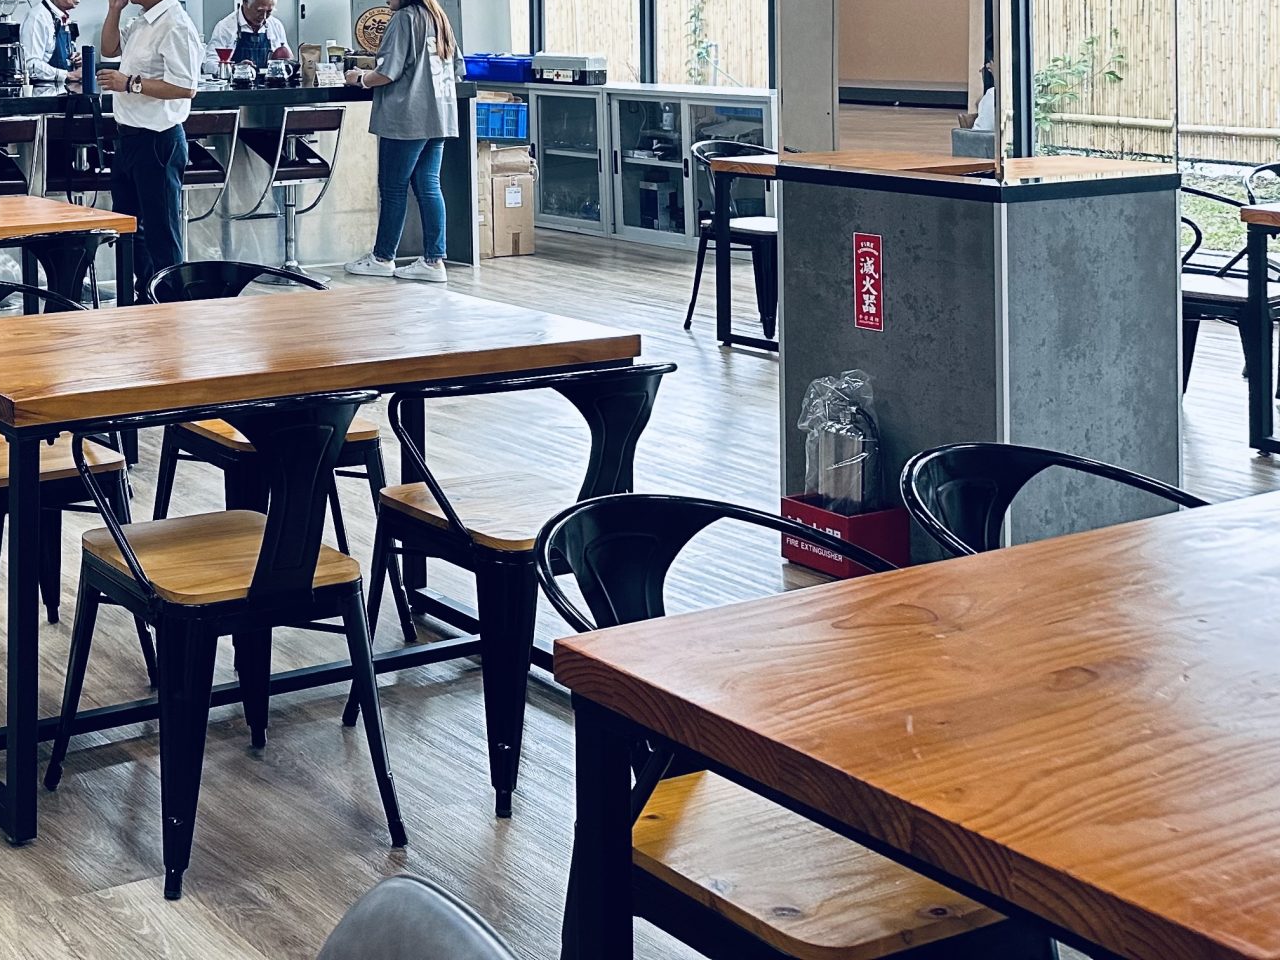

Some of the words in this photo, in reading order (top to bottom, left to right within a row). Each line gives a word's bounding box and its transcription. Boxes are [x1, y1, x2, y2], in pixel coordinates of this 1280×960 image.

[860, 241, 874, 249] FIRE
[859, 256, 879, 314] 滅火器
[786, 537, 800, 548] FIRE
[800, 541, 843, 563] EXTINGUISHER
